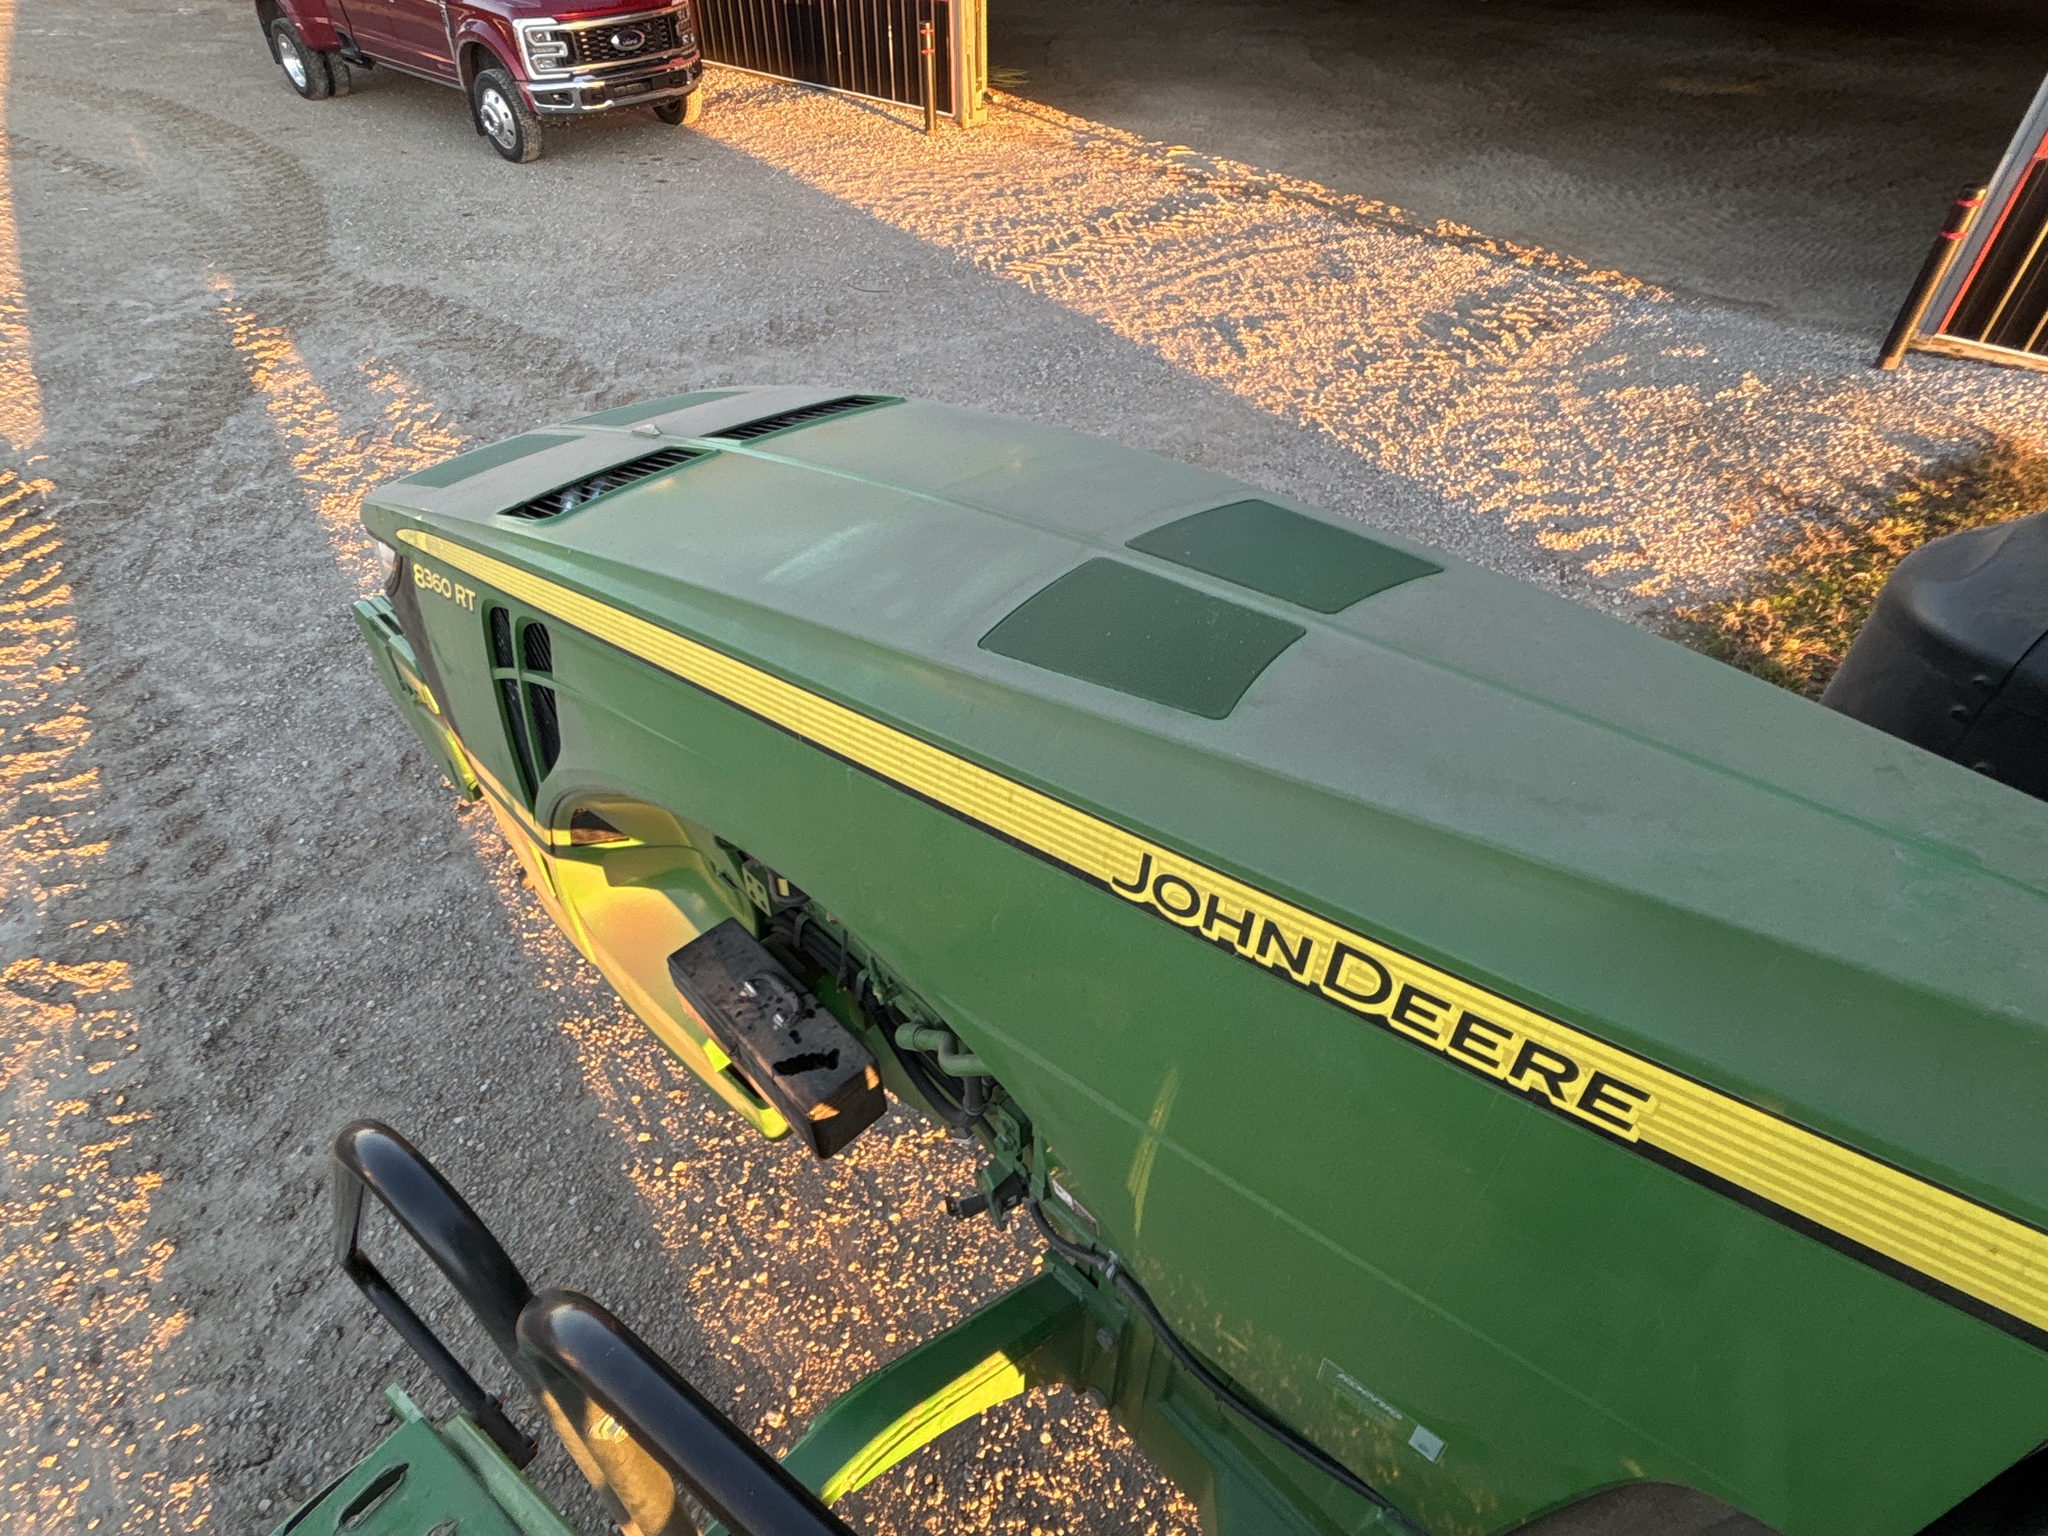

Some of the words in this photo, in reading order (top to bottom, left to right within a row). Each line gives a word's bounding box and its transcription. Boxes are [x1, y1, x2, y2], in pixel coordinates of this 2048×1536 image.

[413, 564, 452, 598] 8360
[455, 584, 476, 611] RT
[1111, 852, 1314, 977] JOHN
[1322, 940, 1652, 1133] DEERE
